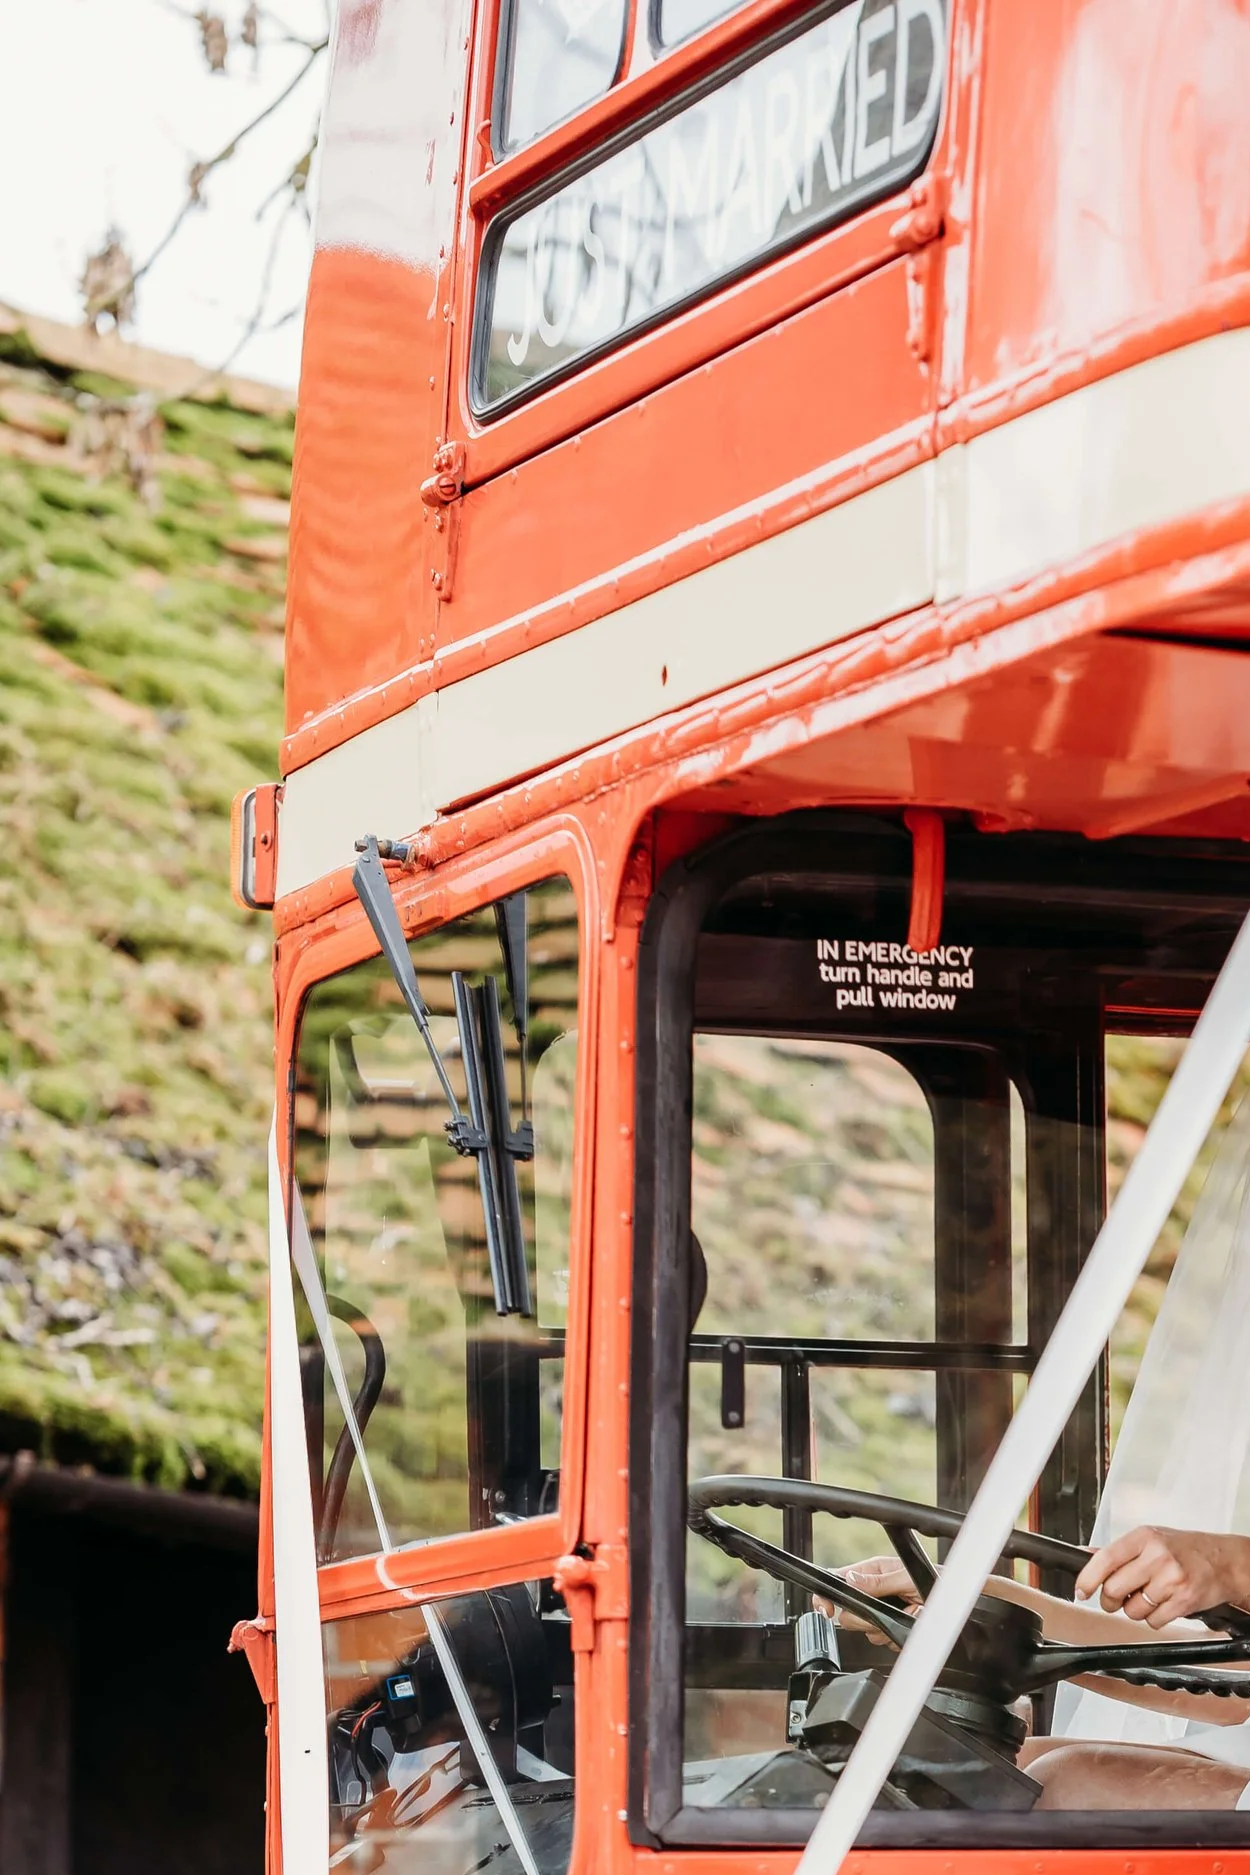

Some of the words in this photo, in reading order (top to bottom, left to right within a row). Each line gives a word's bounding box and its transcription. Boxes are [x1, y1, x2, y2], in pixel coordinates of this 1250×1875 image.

[507, 156, 645, 366] JUST
[663, 0, 943, 285] MARRIED
[816, 939, 839, 961] IN
[844, 940, 974, 966] EMERGENCY
[818, 963, 860, 984] turn
[866, 964, 932, 986] handle
[938, 968, 974, 989] and
[836, 986, 875, 1010] pull
[879, 988, 956, 1010] window
